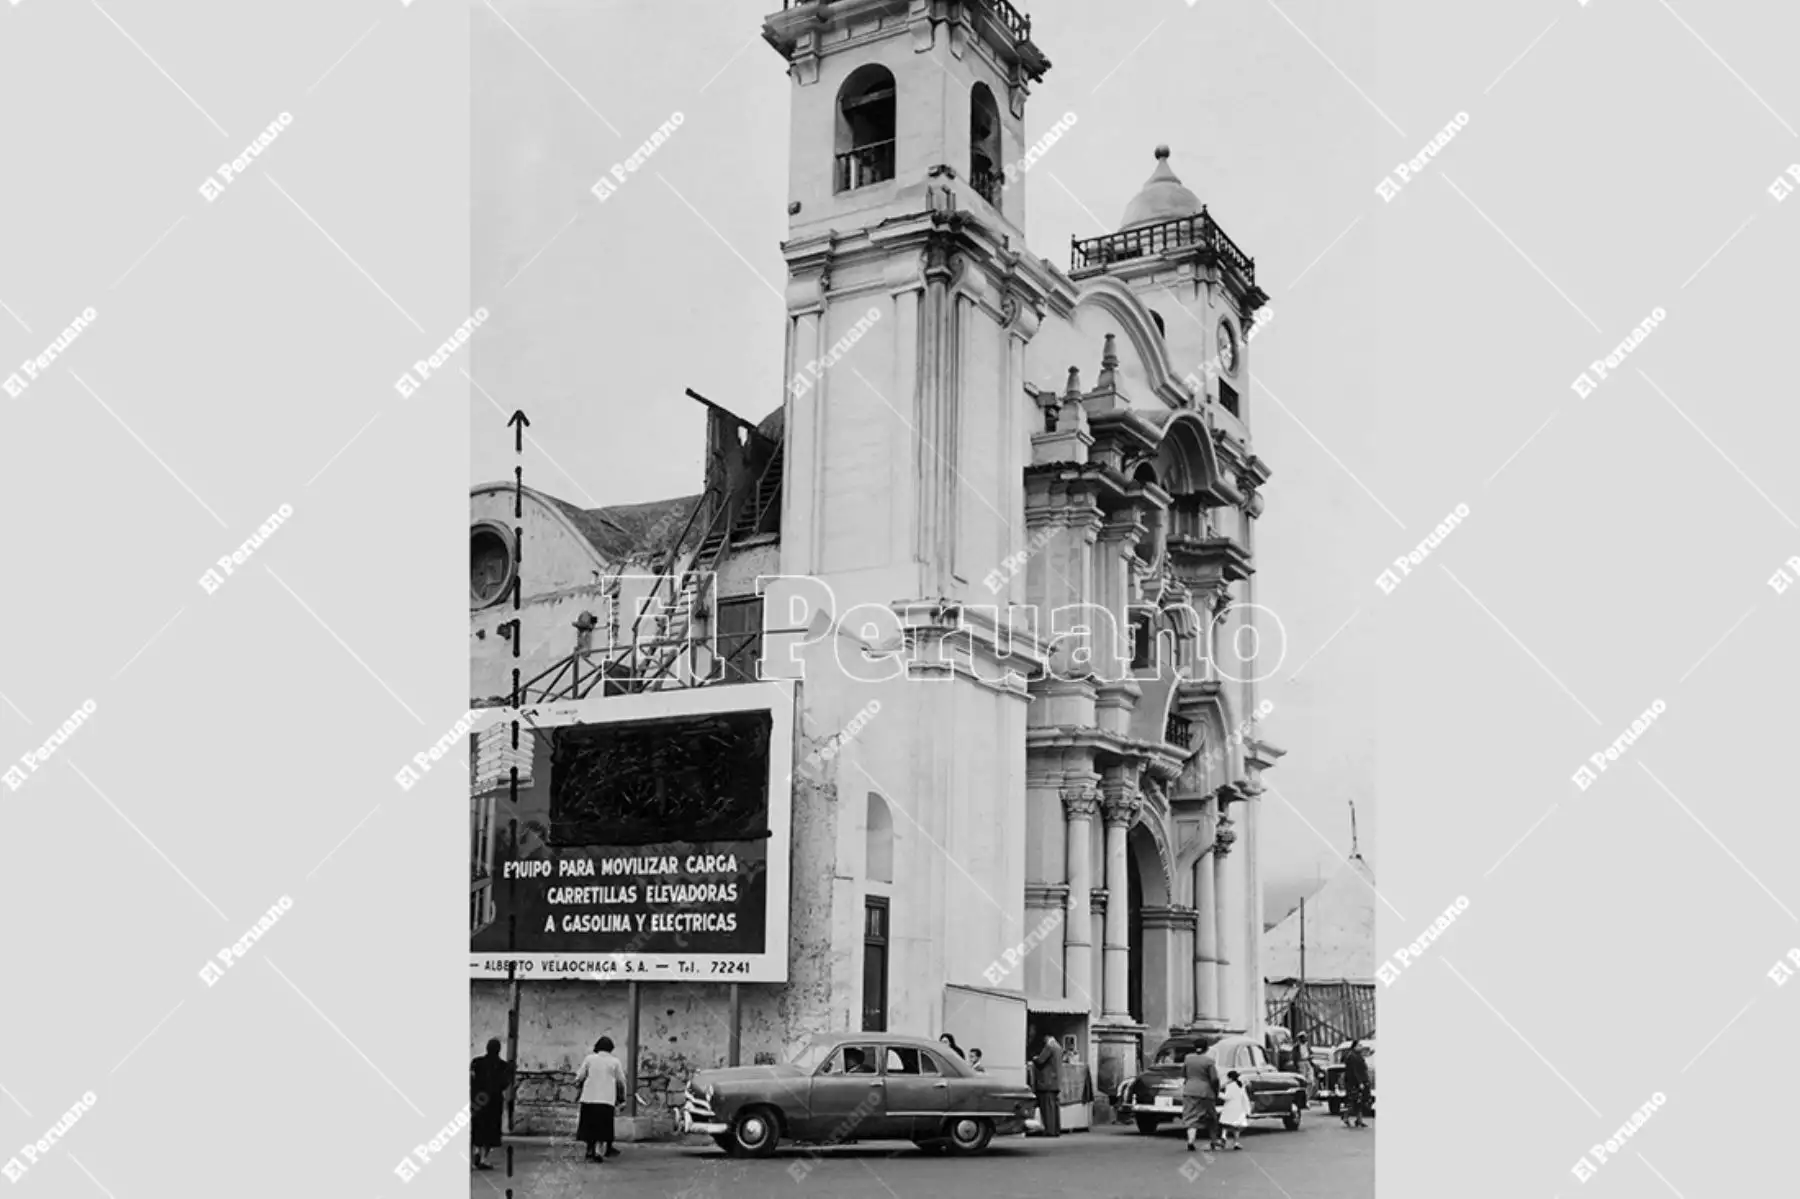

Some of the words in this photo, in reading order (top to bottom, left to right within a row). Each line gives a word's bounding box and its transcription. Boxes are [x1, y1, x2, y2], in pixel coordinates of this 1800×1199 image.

[559, 858, 595, 877] PARA
[601, 856, 679, 876] MOVILIZAR
[686, 854, 738, 874] CARGA
[547, 885, 638, 905] CARRETILLAS
[646, 882, 738, 904] ELEVADORAS
[543, 914, 557, 933] A
[562, 914, 632, 933] GASOLINA
[635, 913, 647, 933] Y
[651, 911, 738, 933] ELECTRICAS
[710, 961, 750, 974] 72241
